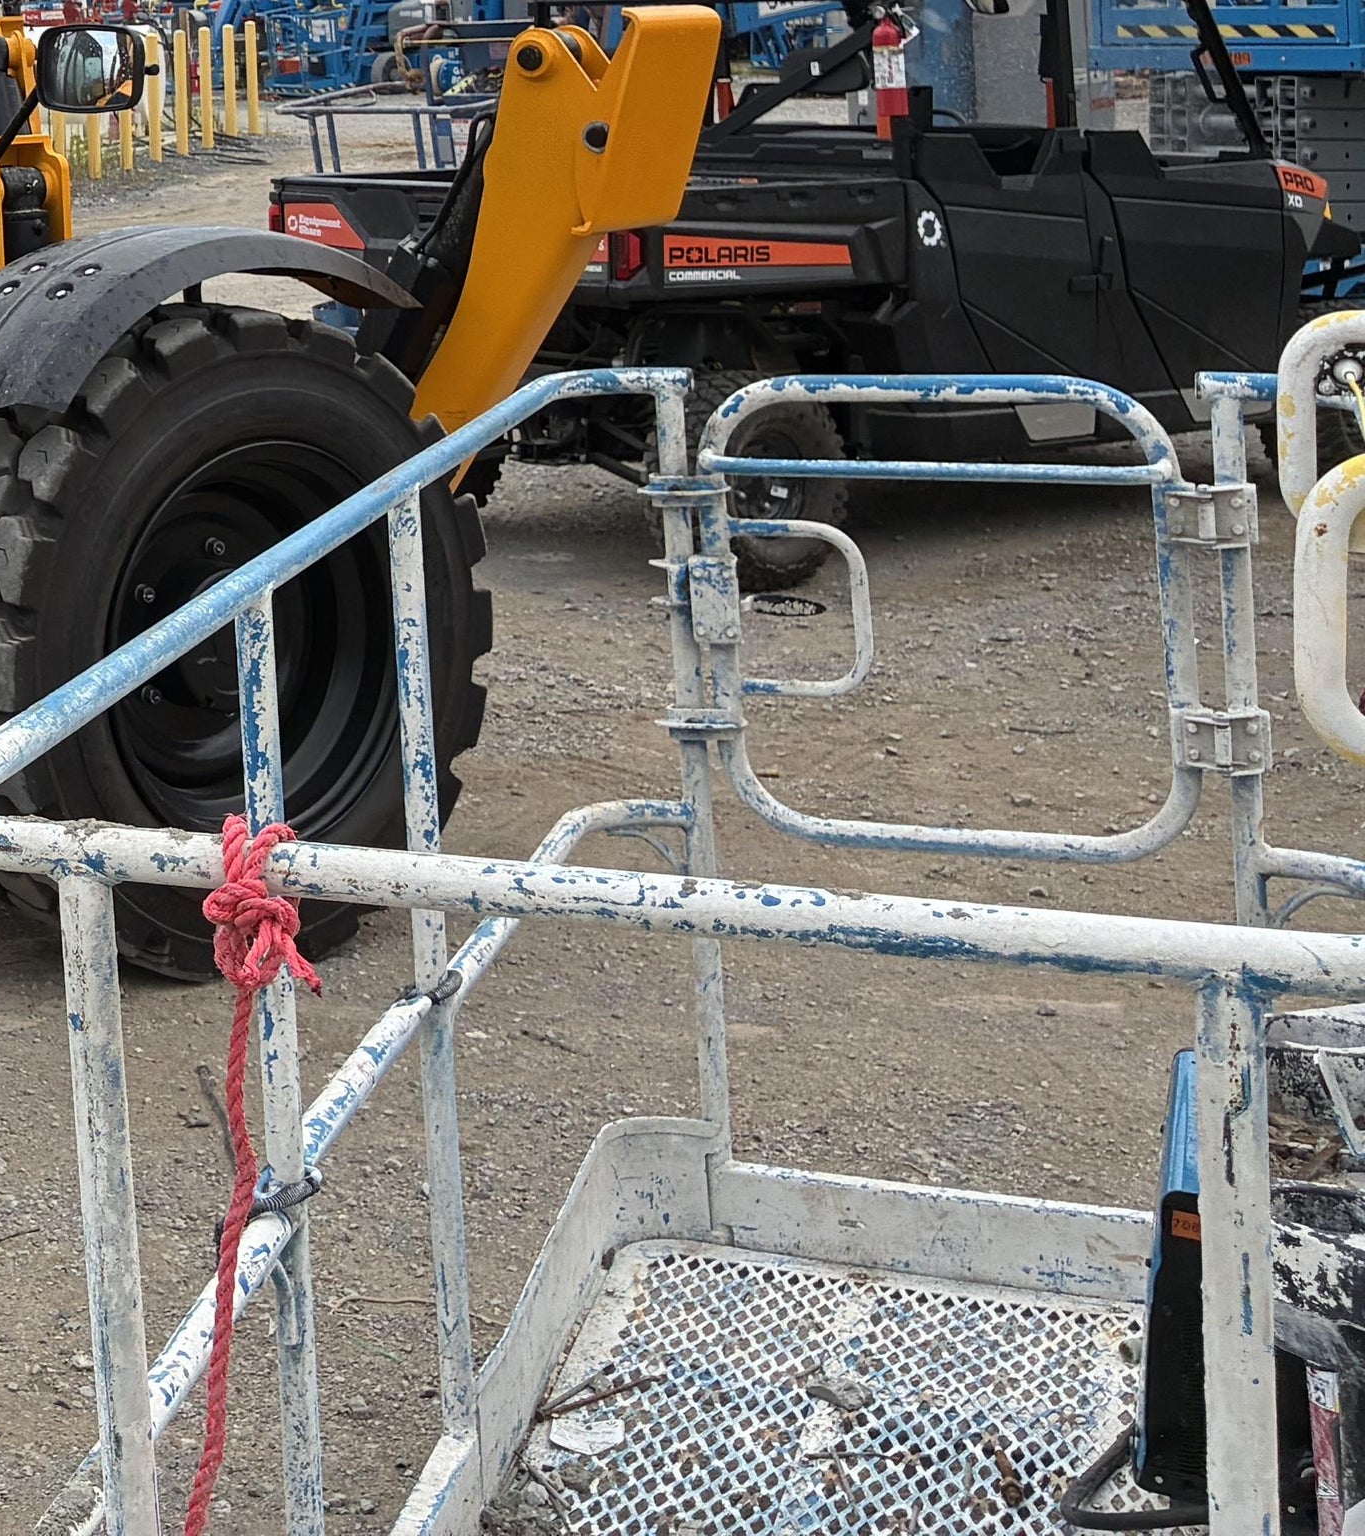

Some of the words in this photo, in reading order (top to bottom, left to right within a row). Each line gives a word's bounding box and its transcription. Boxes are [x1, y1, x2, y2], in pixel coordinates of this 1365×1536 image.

[1282, 171, 1315, 193] PRO
[669, 245, 770, 264] POLARIS
[669, 271, 741, 282] COMMERCIAL
